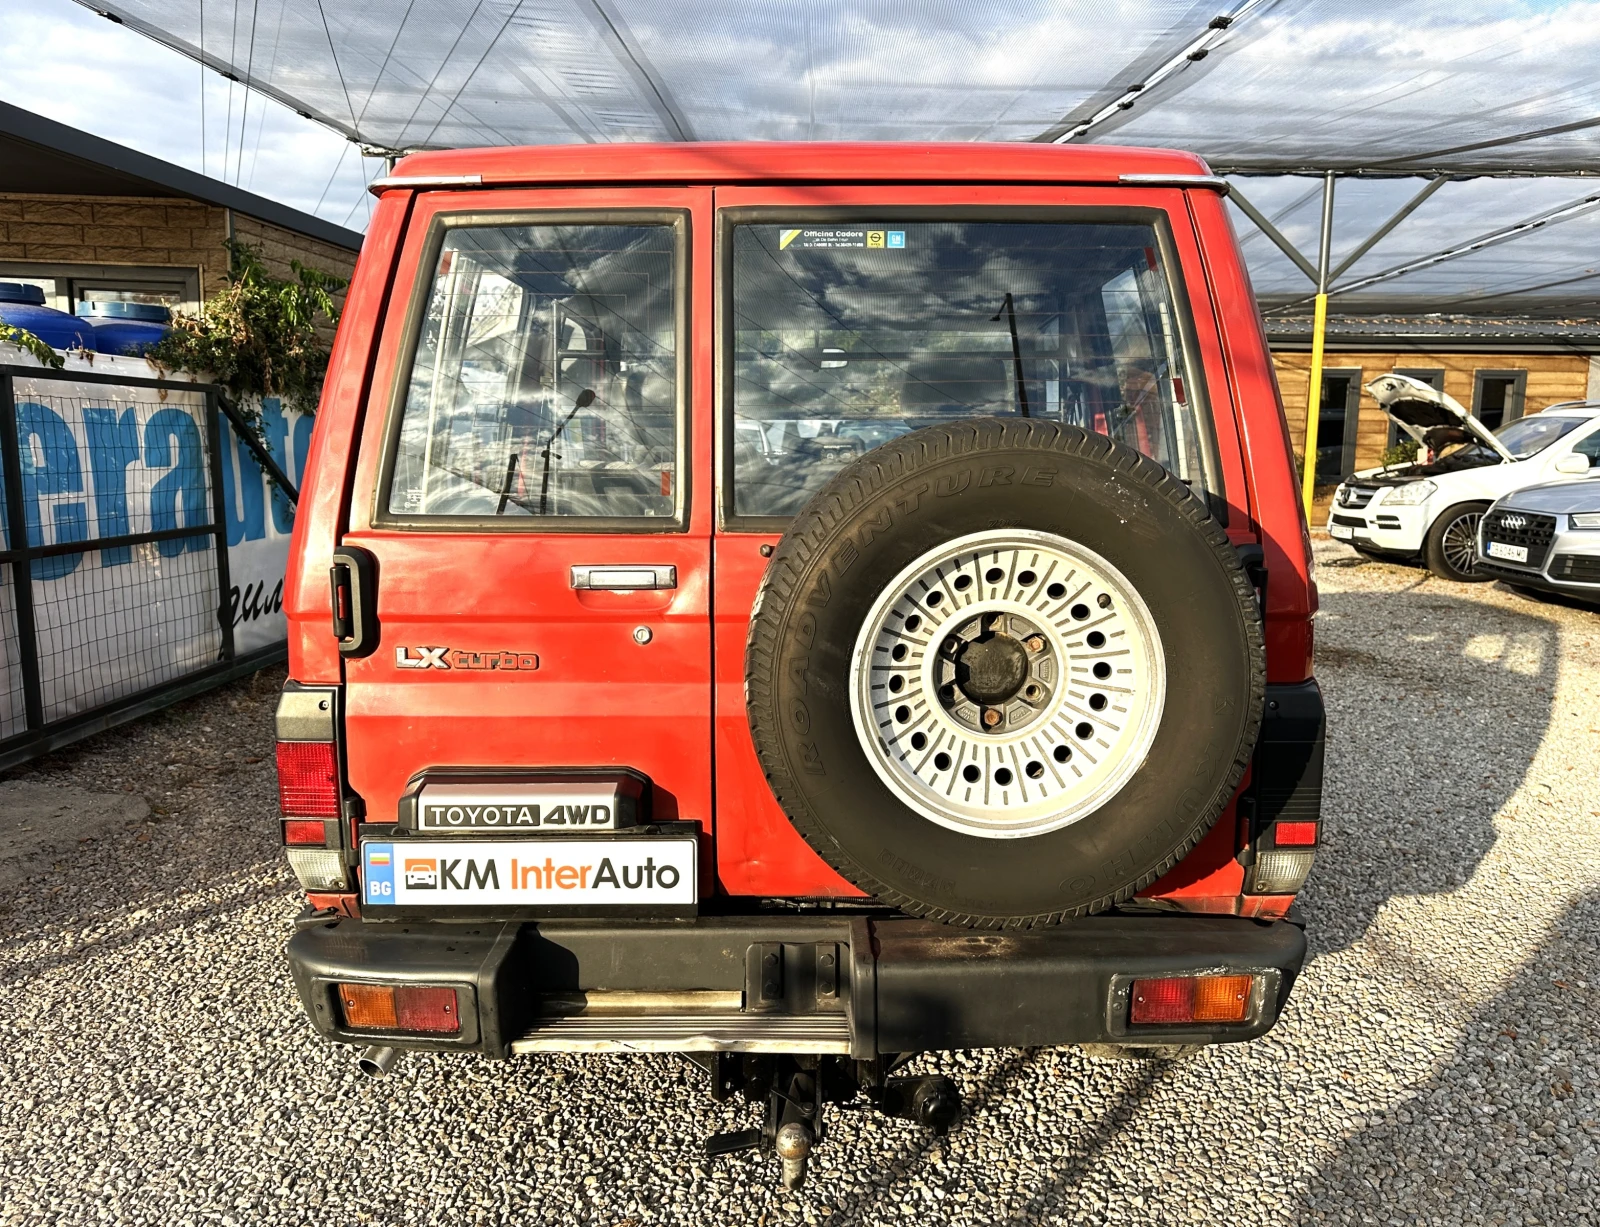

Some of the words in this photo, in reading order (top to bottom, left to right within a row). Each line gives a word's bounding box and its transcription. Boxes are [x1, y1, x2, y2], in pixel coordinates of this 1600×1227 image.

[395, 646, 452, 669] LX
[452, 650, 540, 671] turbo
[430, 806, 535, 826] TOYOTA
[543, 804, 611, 825] 4WD
[440, 858, 500, 890] KM
[510, 856, 681, 890] InterAuto
[370, 882, 392, 896] BG
